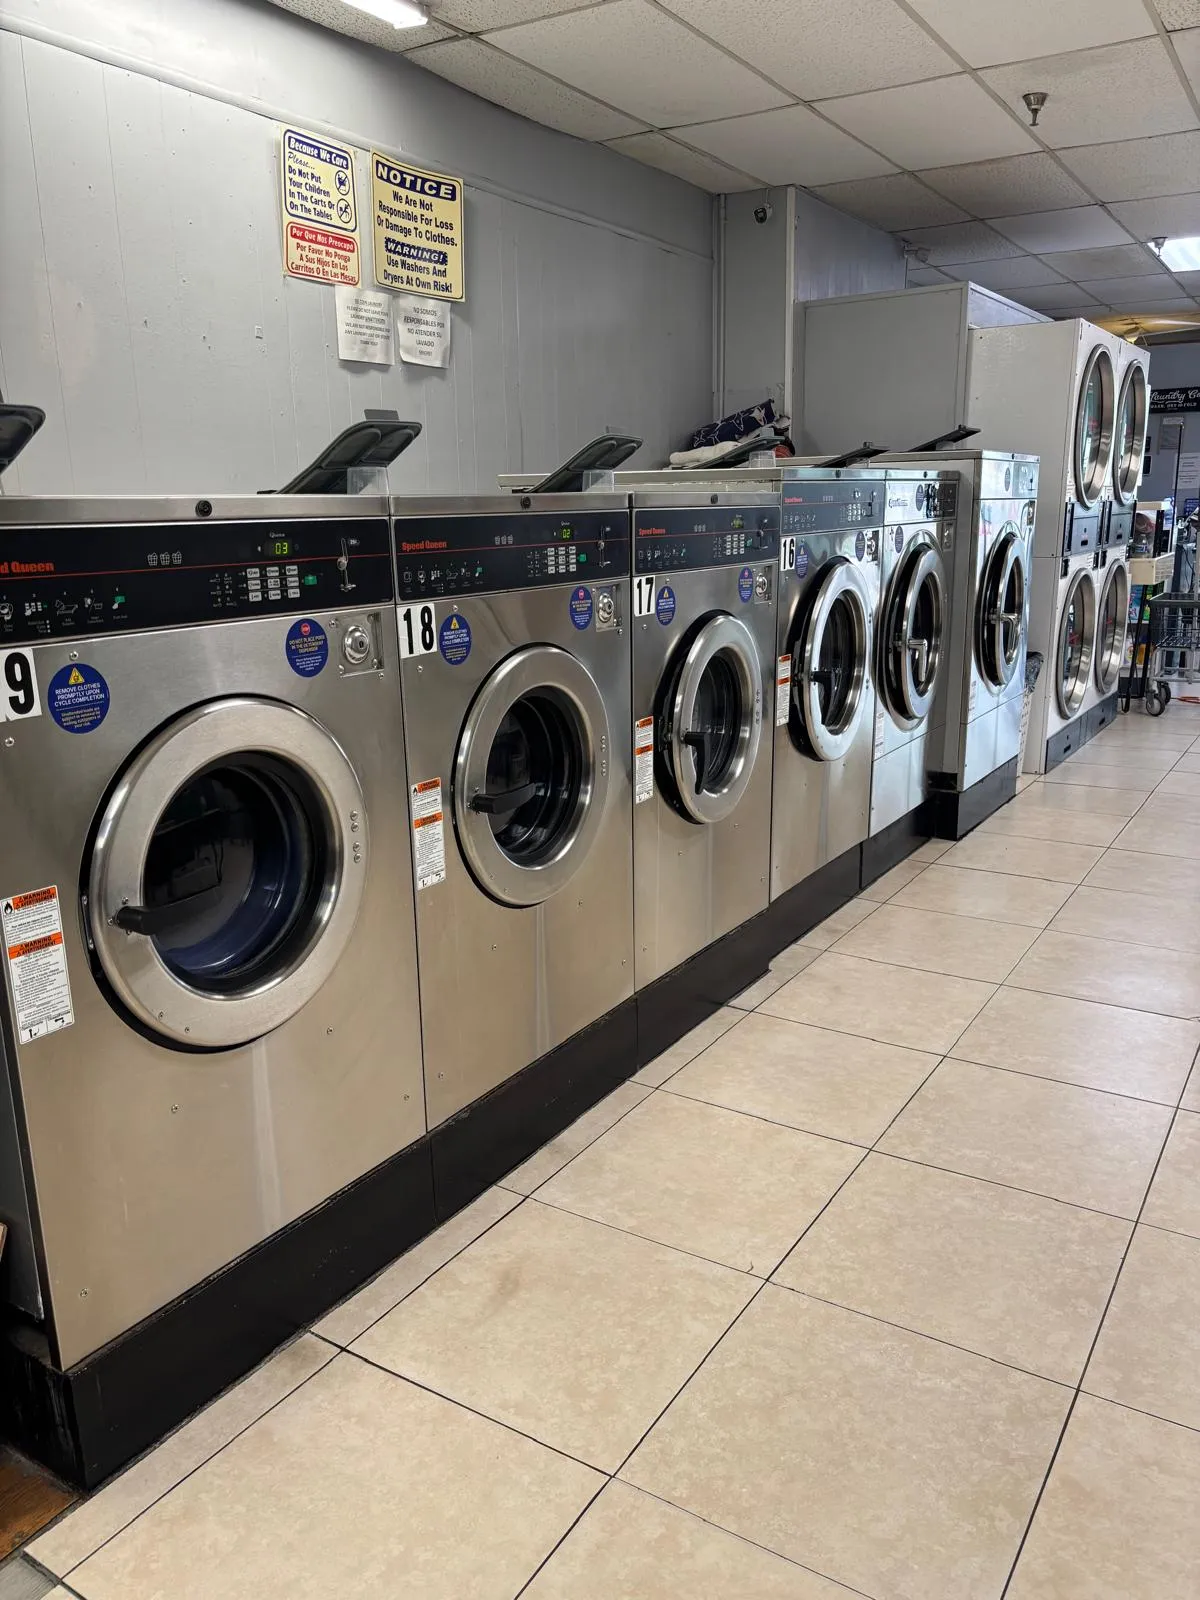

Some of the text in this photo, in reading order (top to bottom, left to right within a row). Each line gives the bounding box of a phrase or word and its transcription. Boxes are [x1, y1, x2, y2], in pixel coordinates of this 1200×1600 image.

[290, 138, 347, 168] Because We Care
[288, 165, 321, 184] Do Not Put
[378, 164, 453, 198] NOTICE
[289, 177, 330, 197] Your Children
[289, 189, 335, 210] In The Carts Or
[392, 190, 433, 212] We Are Not
[290, 201, 332, 220] On The Tables
[379, 200, 454, 230] Responsible For Loss
[292, 227, 302, 237] Por
[304, 231, 315, 241] Que
[317, 234, 327, 244] Nos
[377, 215, 457, 247] Or Damage To Clothes.
[296, 242, 350, 263] Por Favor No Ponga
[387, 242, 444, 261] WARNING!
[291, 262, 315, 275] Carritos
[322, 268, 329, 276] En
[330, 270, 340, 278] Las
[341, 272, 356, 283] Mesas
[300, 254, 348, 272] A Sus Hijos En Los
[387, 255, 446, 278] Use Washers And
[384, 269, 452, 293] Dryers At Own Risk!
[563, 529, 570, 538] 02
[276, 543, 288, 554] 03
[402, 540, 447, 552] Speed Queen
[782, 539, 795, 569] 16
[11, 561, 54, 573] Queen
[636, 577, 654, 615] 17
[404, 606, 434, 654] 18
[4, 652, 34, 714] 9
[55, 687, 76, 695] REMOVE
[58, 691, 84, 700] PROMPTLY
[72, 694, 104, 704] COMPLETION
[24, 890, 50, 900] WARNING
[25, 936, 52, 948] WARNING
